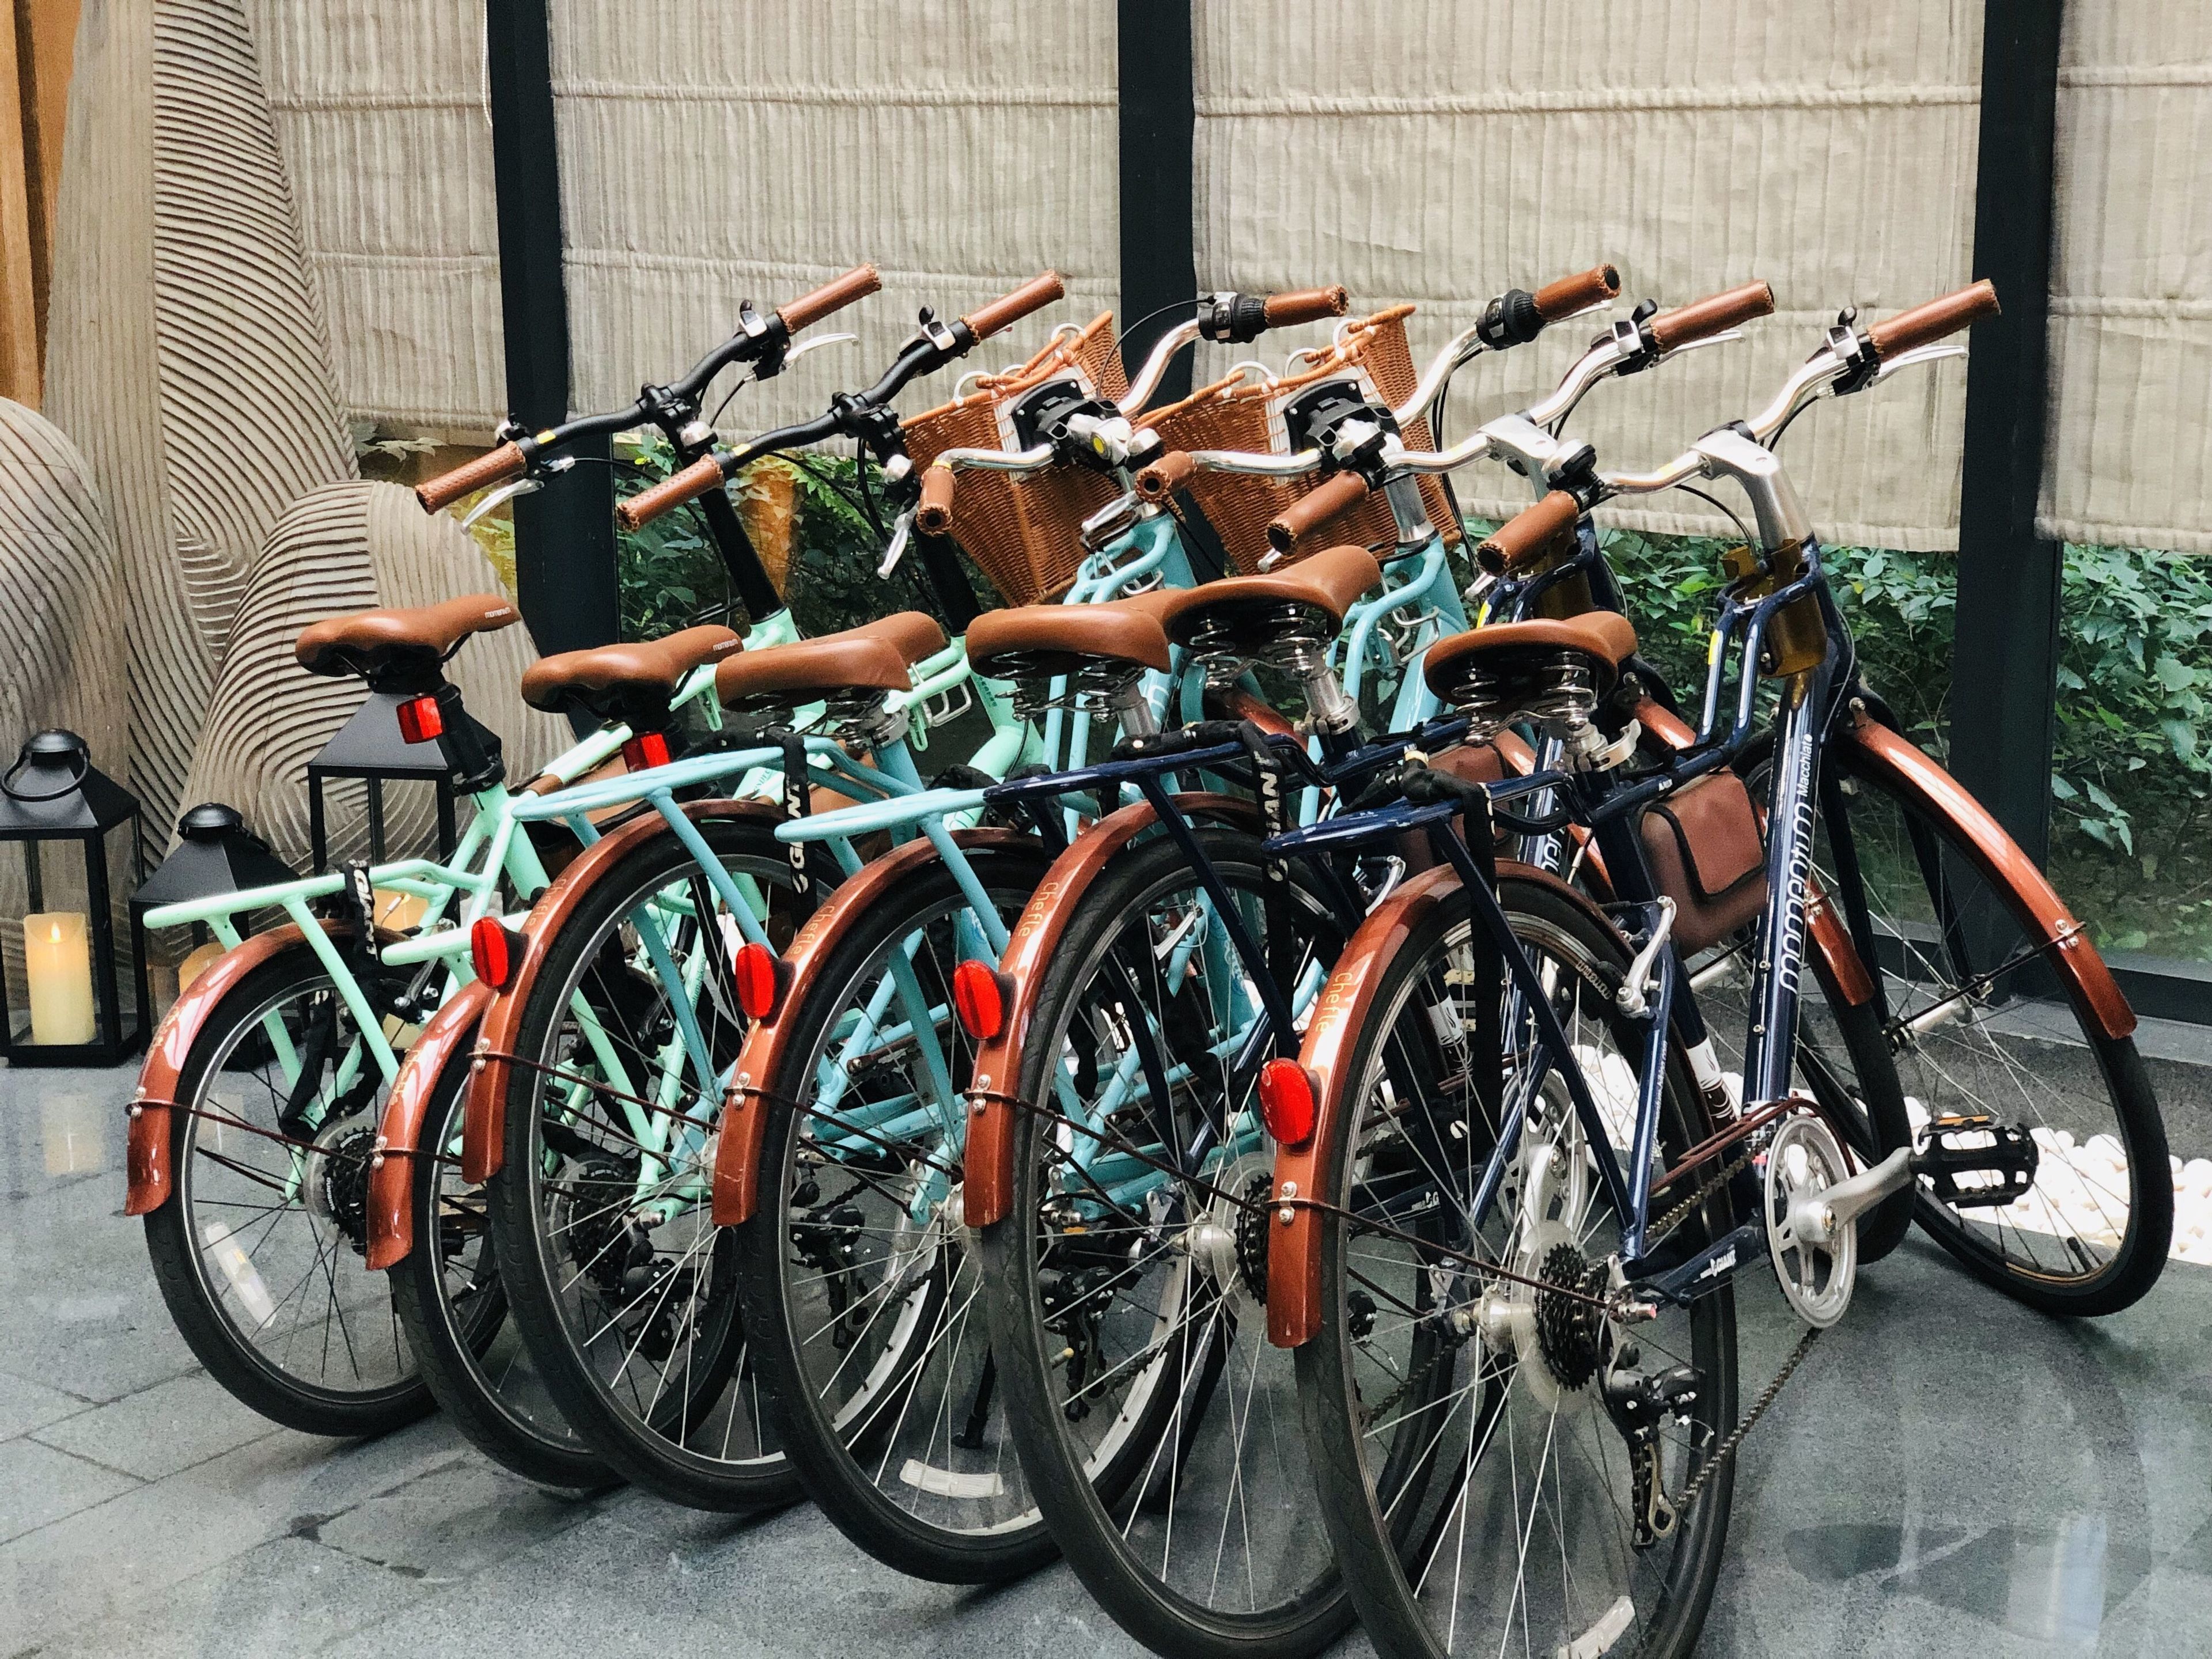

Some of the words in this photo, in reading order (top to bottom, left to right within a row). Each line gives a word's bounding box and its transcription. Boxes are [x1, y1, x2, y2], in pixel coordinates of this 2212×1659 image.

[786, 775, 805, 869] GINT
[1779, 801, 1812, 993] momentum
[1796, 734, 1813, 798] Macchiato
[790, 905, 835, 956] Chefle
[1020, 881, 1059, 938] Chefle
[1315, 972, 1354, 1033] Chefle
